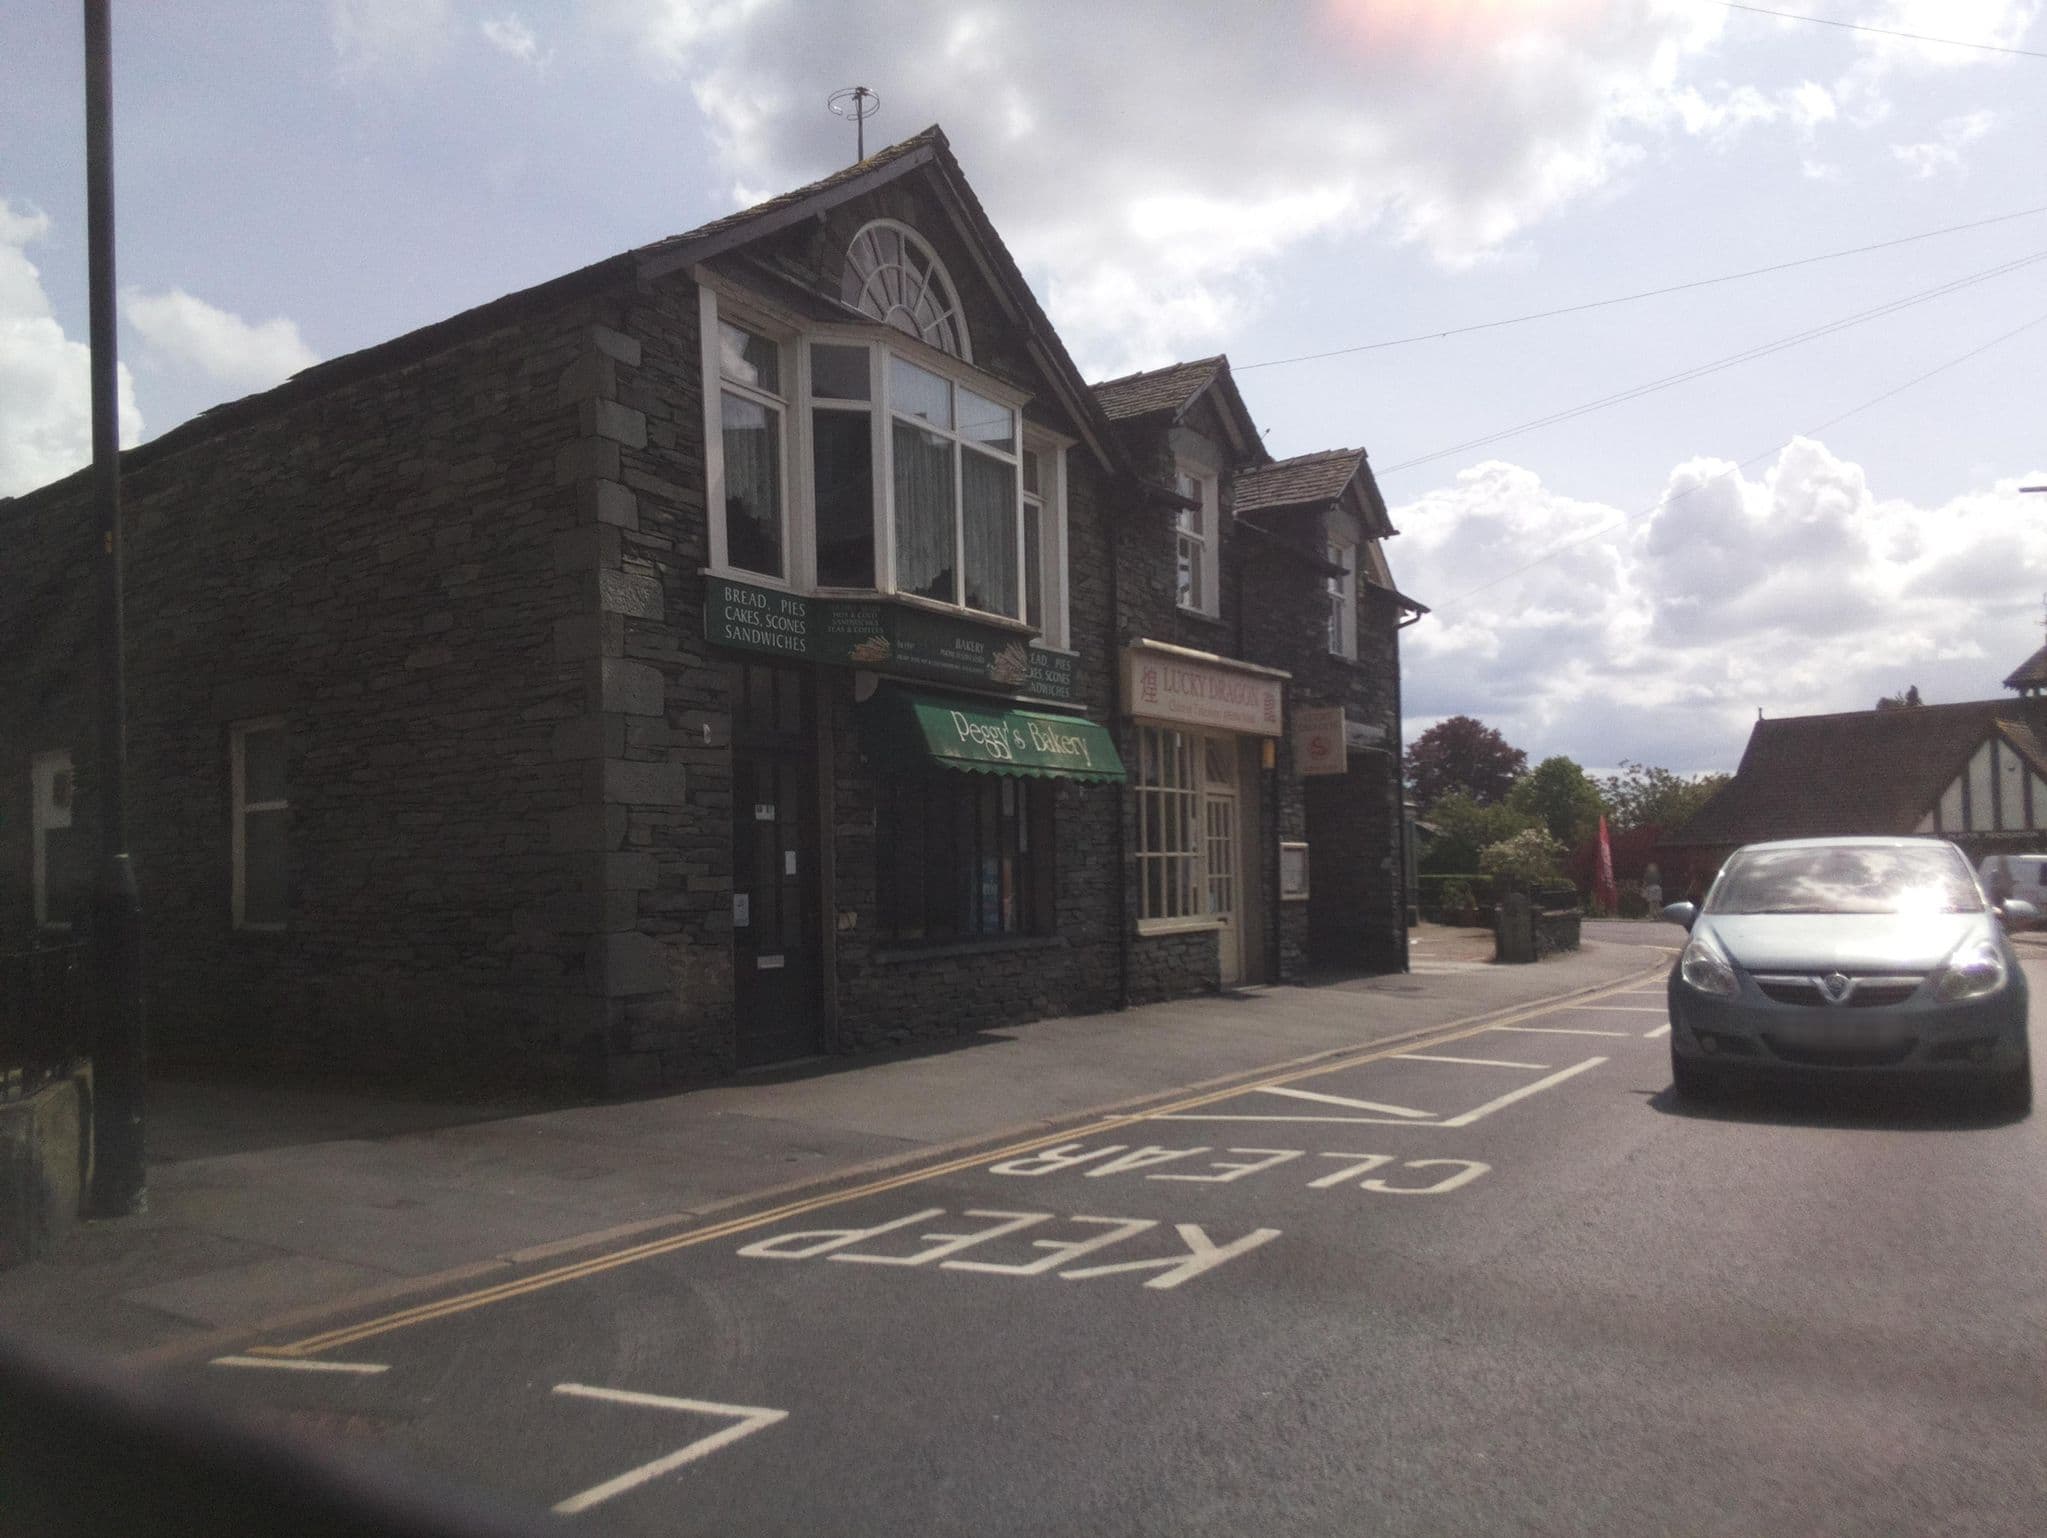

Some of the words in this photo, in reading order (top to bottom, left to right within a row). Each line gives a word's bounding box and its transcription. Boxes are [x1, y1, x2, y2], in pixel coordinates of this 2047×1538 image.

[780, 599, 806, 617] PIES
[765, 614, 806, 635] SCONES
[724, 624, 806, 653] SANDWICHES
[954, 638, 985, 654] BAKERY
[1055, 658, 1071, 671] PIES
[1045, 670, 1070, 685] SCONES
[1162, 664, 1206, 698] LUCKY
[1208, 674, 1260, 707] DRAGON
[950, 710, 1026, 760] Peggy's
[1027, 722, 1092, 768] Bakery
[987, 1142, 1495, 1196] CLEAR
[735, 1208, 1283, 1291] KEEP
